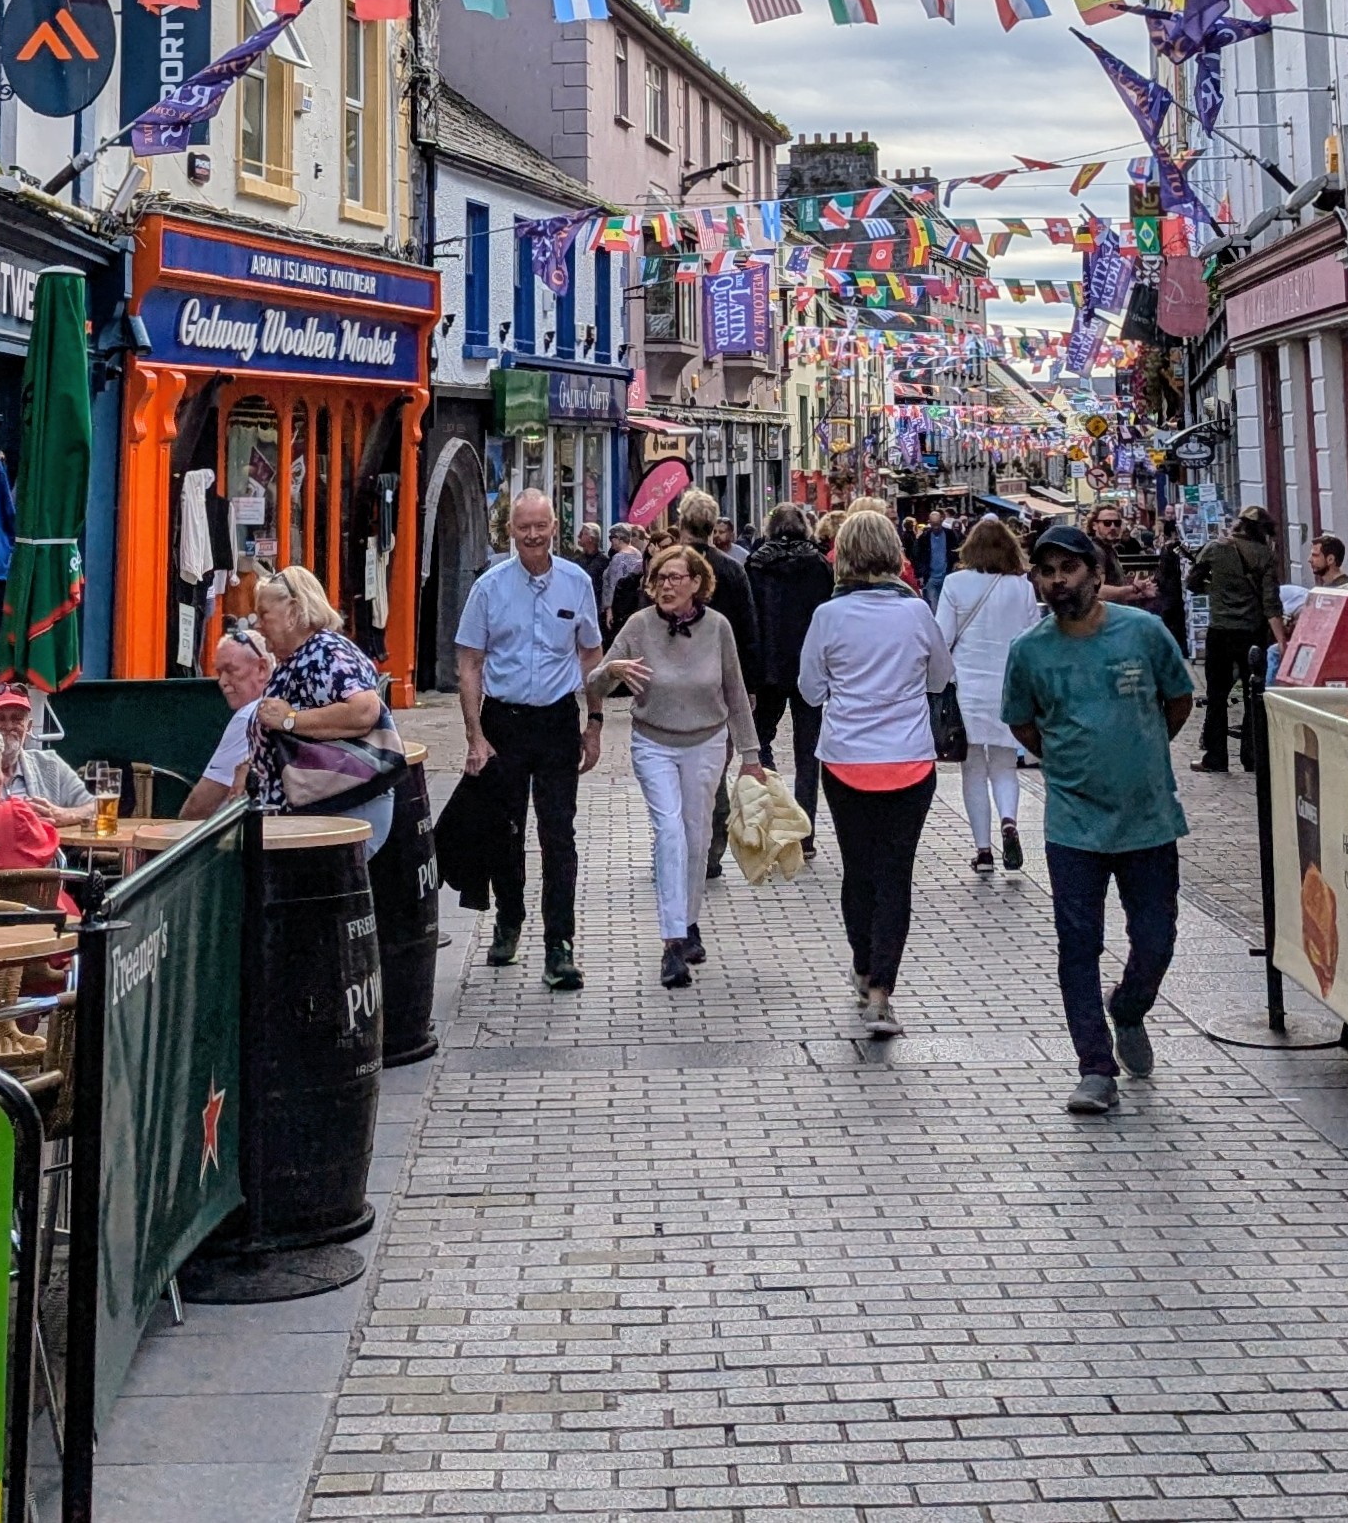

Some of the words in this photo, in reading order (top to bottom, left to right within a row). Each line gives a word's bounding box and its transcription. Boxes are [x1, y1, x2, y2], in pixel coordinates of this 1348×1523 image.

[251, 255, 281, 278] ARAN
[282, 261, 328, 285] ISLANDS
[329, 268, 376, 295] KNITWEAR
[753, 274, 765, 327] WELCOME
[179, 298, 258, 362] Galway
[260, 309, 336, 359] Woollen
[338, 320, 397, 365] Market
[710, 276, 732, 350] QUARTER
[729, 287, 750, 345] LATIN
[754, 331, 766, 346] TO
[559, 381, 588, 409] GALWAY
[590, 383, 610, 411] GIFTS
[112, 910, 168, 1005] Freeney's
